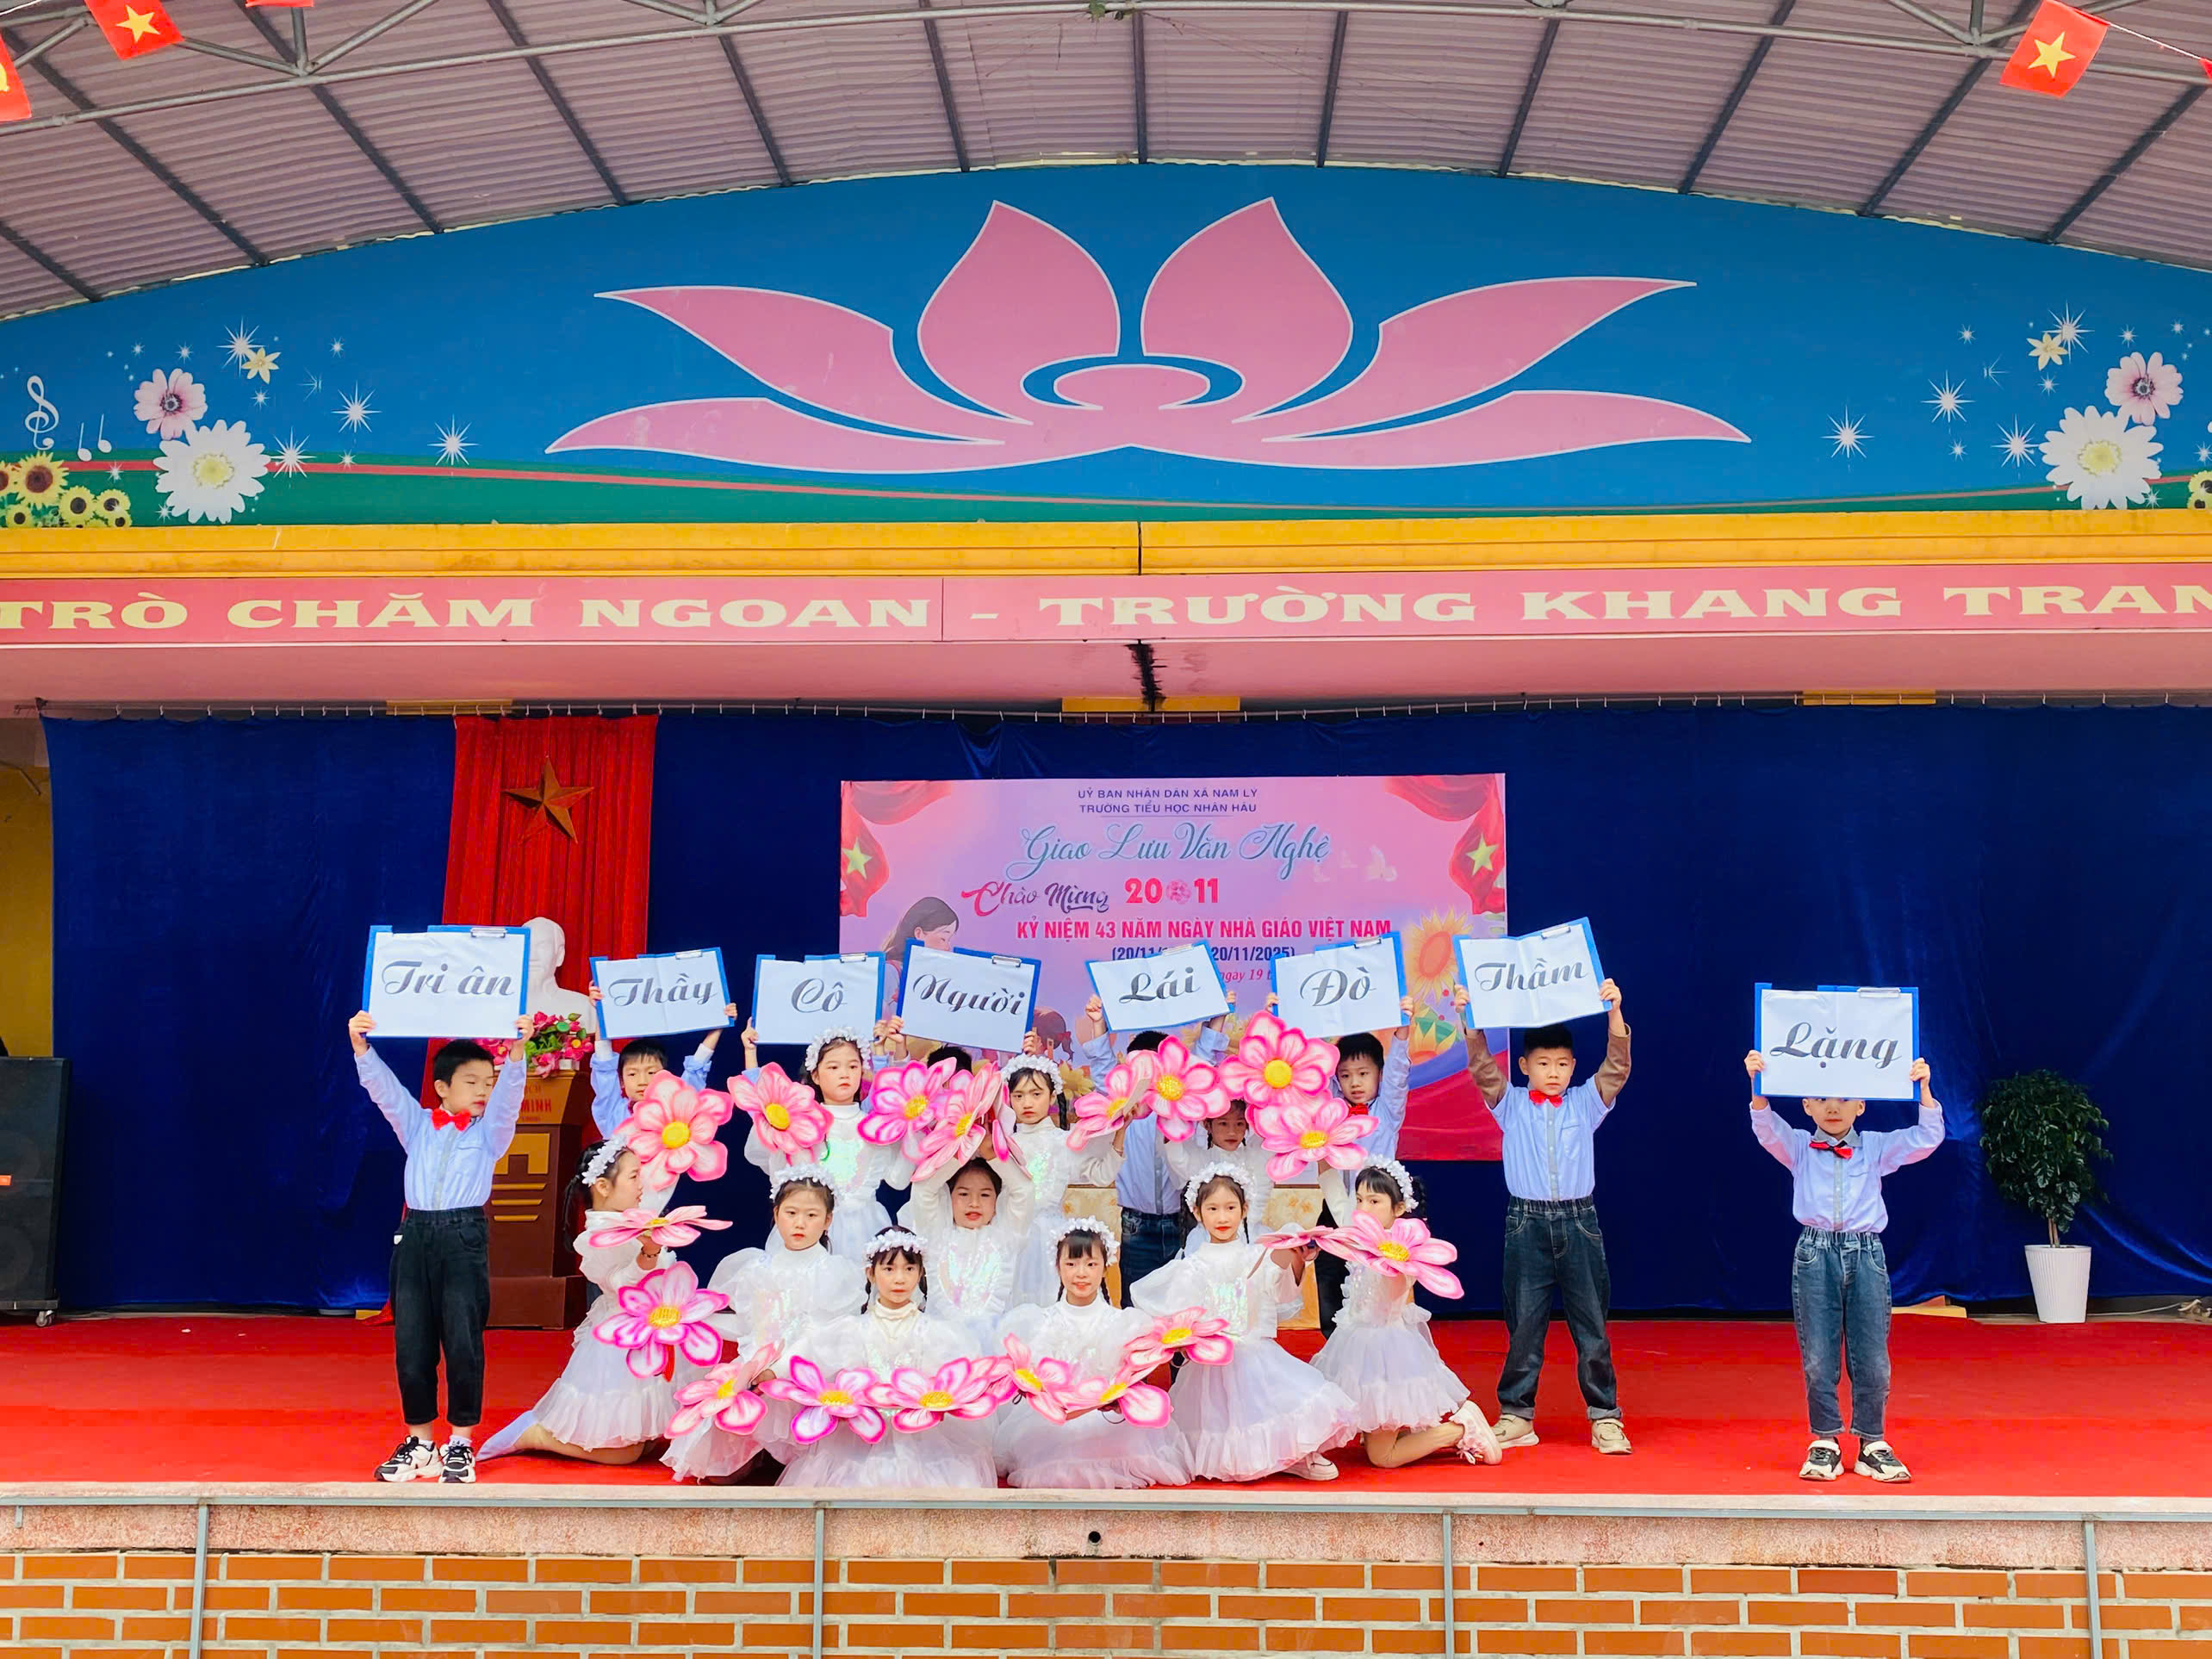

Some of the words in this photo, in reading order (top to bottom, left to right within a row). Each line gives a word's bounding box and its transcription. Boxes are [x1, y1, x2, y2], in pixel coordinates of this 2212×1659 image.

[0, 592, 188, 629] TRÒ
[227, 593, 534, 629] CHĂM
[579, 599, 929, 627] NGOAN
[1039, 586, 1476, 626] TRƯỜNG
[1521, 587, 1903, 620] KHANG
[1079, 802, 1130, 813] TRƯỜNG
[1134, 800, 1161, 813] TIỂU
[1165, 804, 1190, 814] HỌC
[1194, 802, 1228, 812] NHÂN
[1097, 789, 1122, 798] BAN
[1127, 787, 1160, 798] NHÂN
[1164, 787, 1189, 798] DÂN
[1213, 789, 1240, 798] NAM
[1005, 822, 1093, 882] Giao
[1098, 823, 1171, 861] Lưu
[1173, 822, 1233, 861] Văn
[1239, 823, 1330, 881] Nghệ
[961, 881, 1039, 917] Chào
[1044, 882, 1109, 914] Mừng
[1016, 916, 1040, 939] KỶ
[1044, 917, 1090, 942] NIỆM
[1096, 921, 1116, 938] 43
[1122, 917, 1162, 938] NĂM
[1168, 916, 1215, 938] NGÀY
[1220, 916, 1257, 938] NHÀ
[1262, 916, 1302, 938] GIÁO
[1308, 916, 1345, 942] VIỆT
[1351, 920, 1391, 938] NAM
[382, 960, 448, 995] Tri
[457, 966, 515, 996] ân
[608, 972, 718, 1007] Thầy
[1118, 966, 1201, 1004] Lái
[1249, 969, 1264, 980] 19
[1299, 966, 1376, 1007] Đò
[1474, 958, 1589, 992] Thầm
[791, 978, 848, 1013] Cô
[913, 973, 1026, 1016] Người
[1769, 1022, 1902, 1070] Lặng
